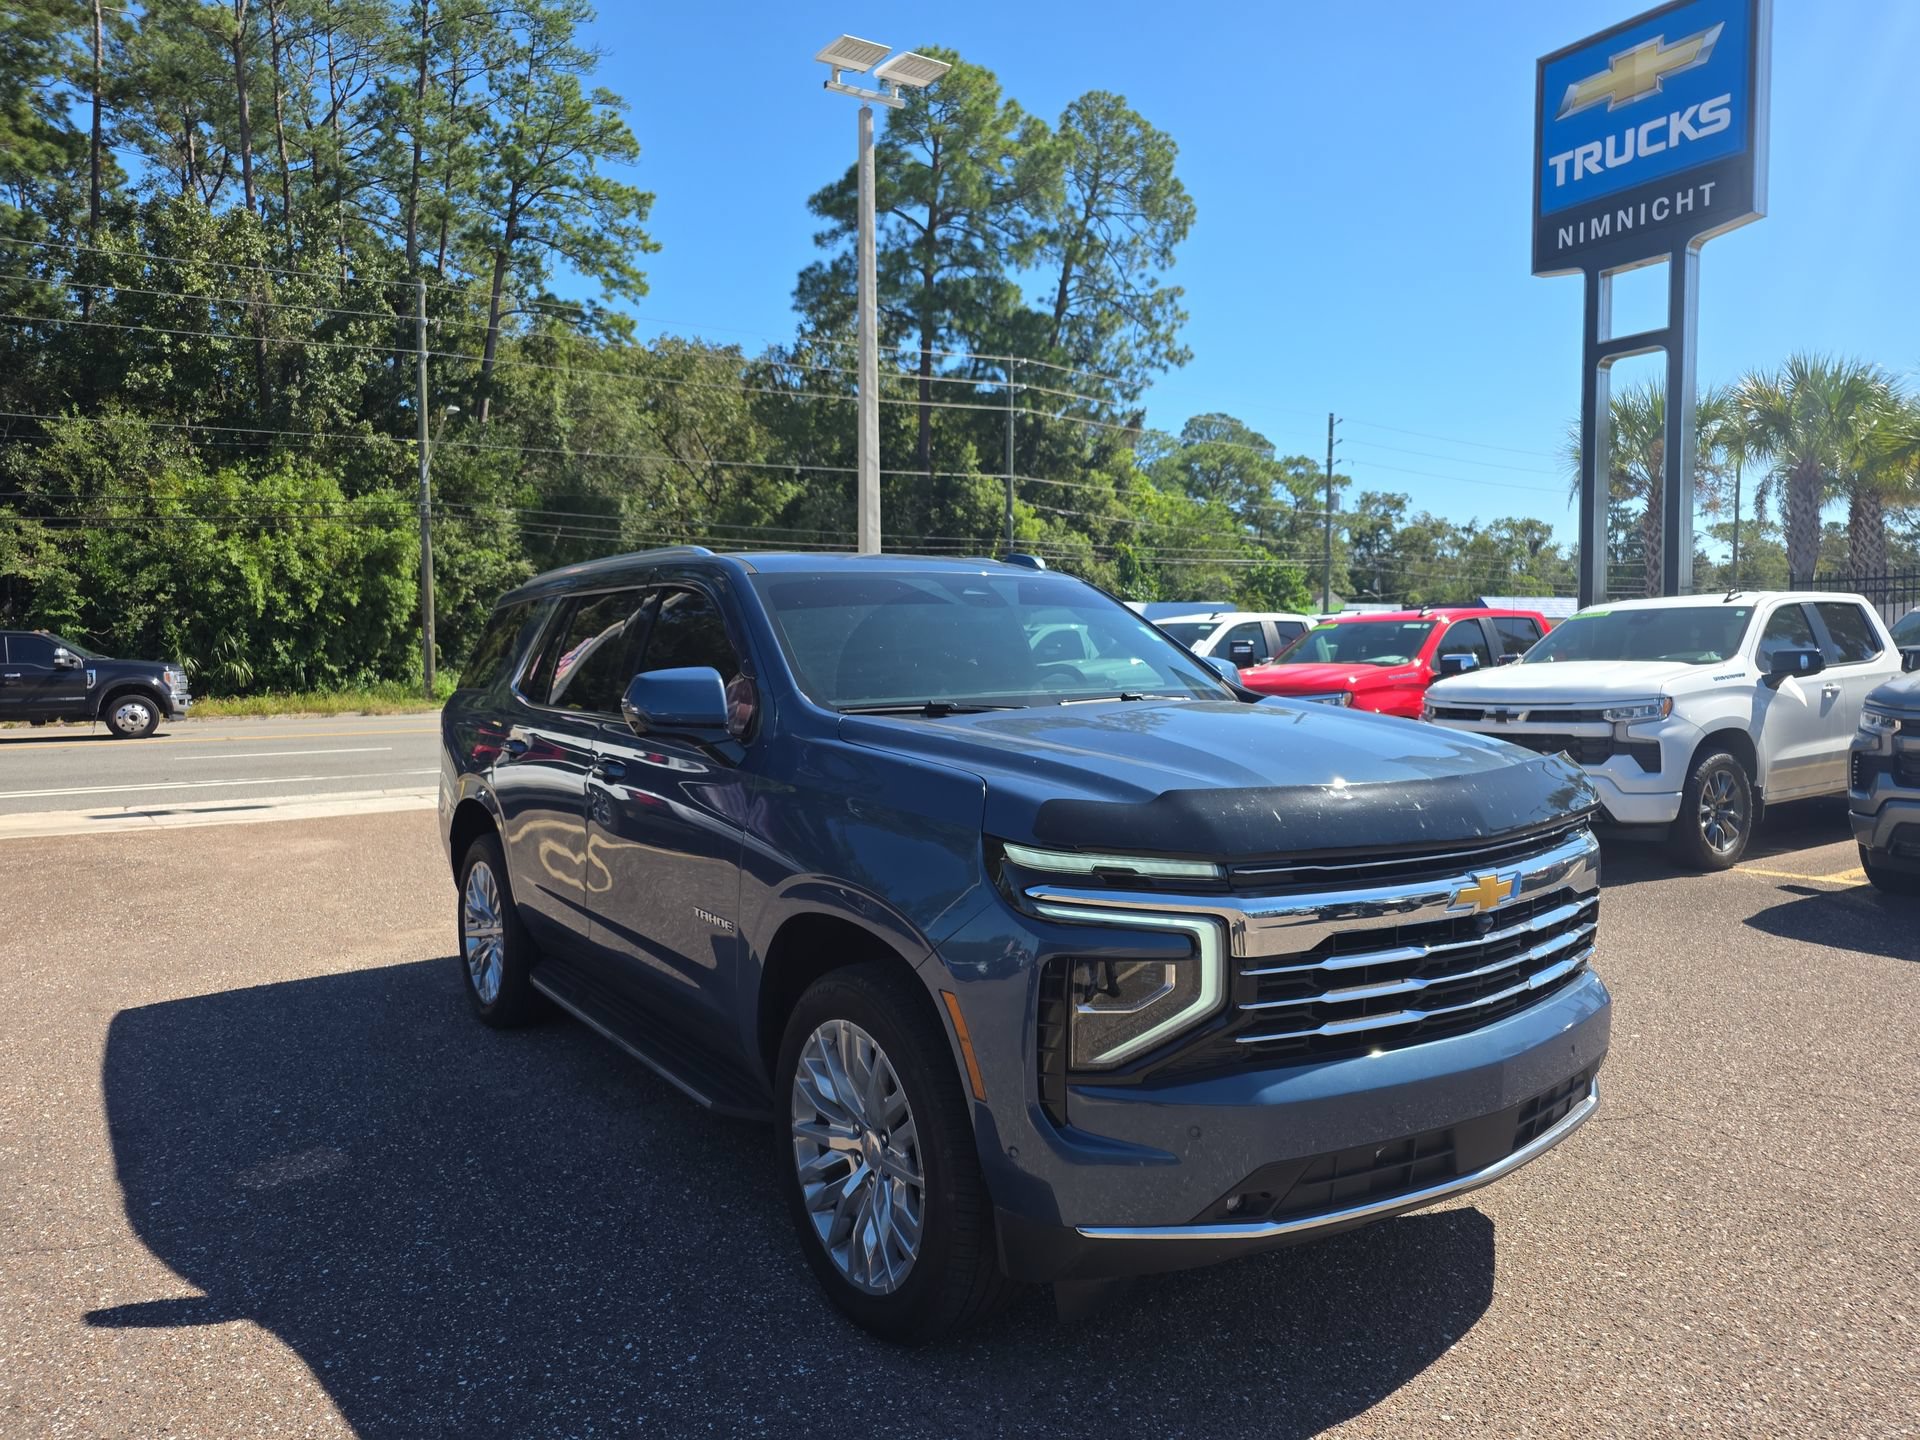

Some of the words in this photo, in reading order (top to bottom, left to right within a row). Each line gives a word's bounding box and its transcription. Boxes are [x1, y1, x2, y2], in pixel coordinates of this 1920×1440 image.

[1549, 93, 1731, 187] TRUCKS
[1558, 182, 1716, 249] NIMNICHT
[693, 906, 734, 932] TAHOE
